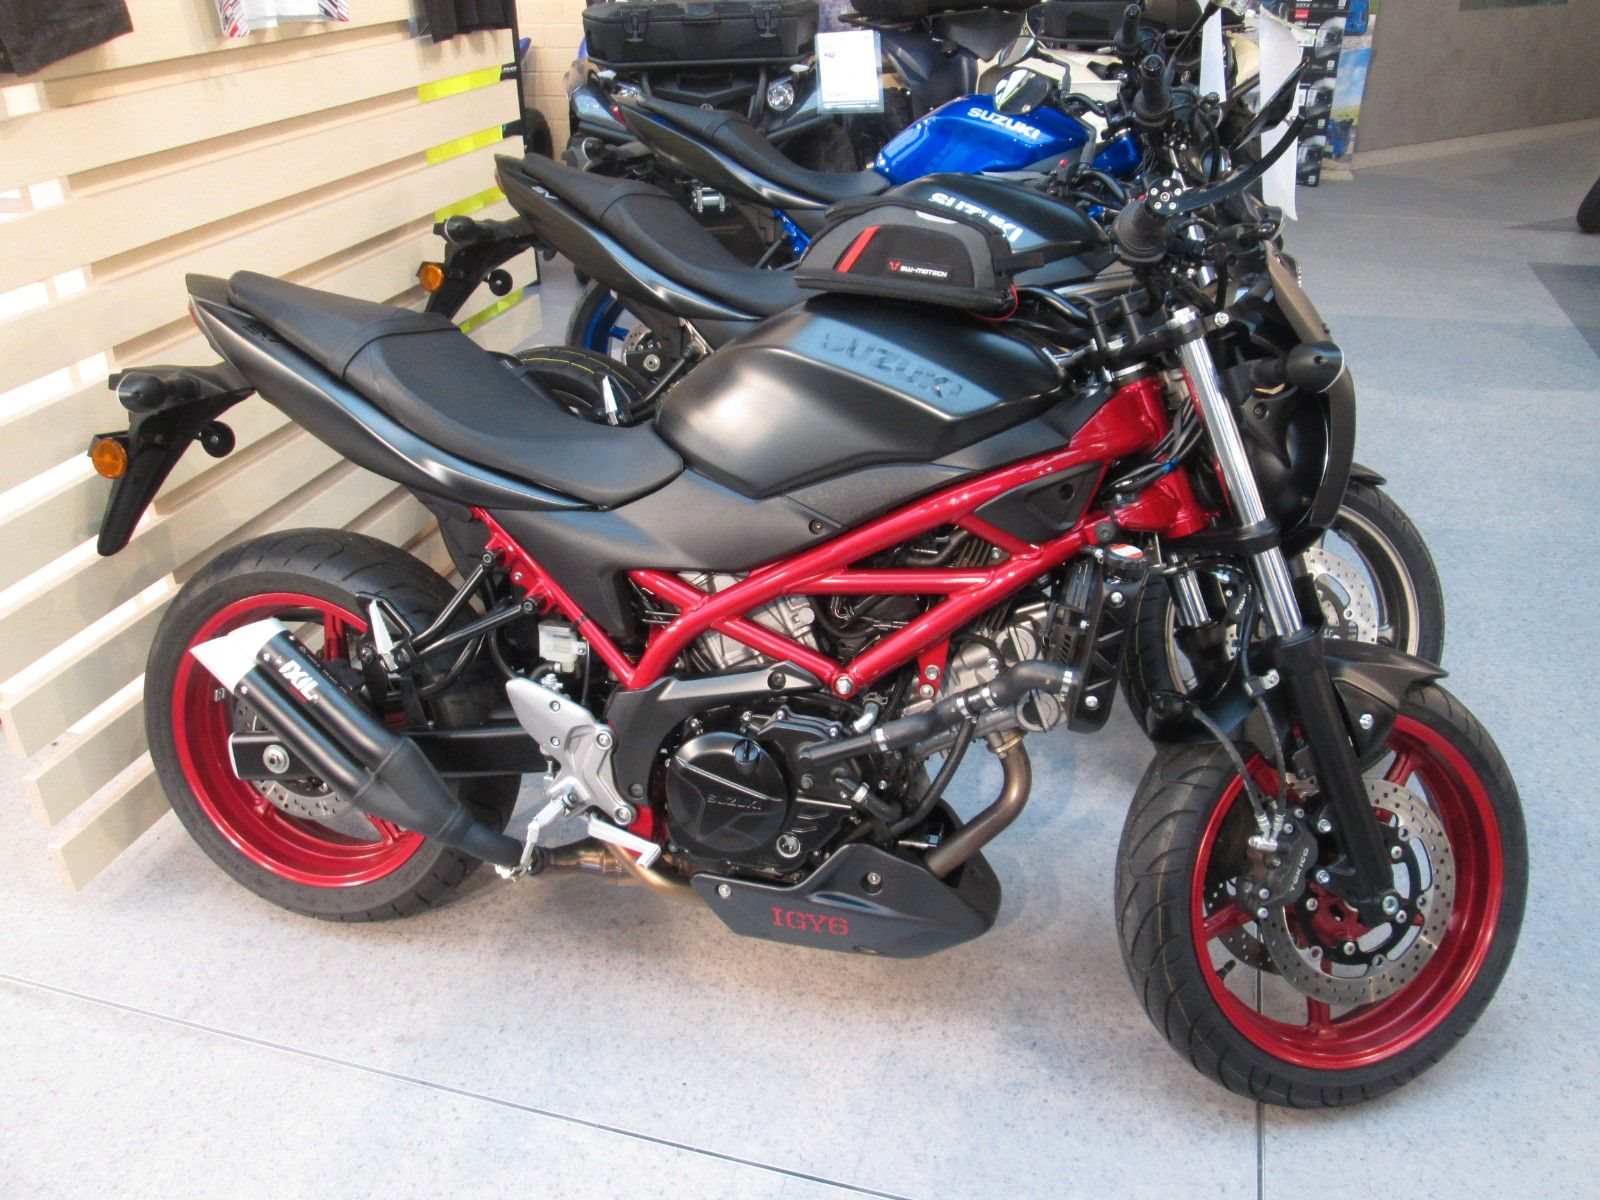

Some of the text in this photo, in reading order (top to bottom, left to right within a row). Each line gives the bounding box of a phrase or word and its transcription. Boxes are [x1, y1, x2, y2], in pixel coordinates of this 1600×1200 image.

[967, 107, 1041, 140] SUZUKI
[821, 331, 965, 398] SUZUKI
[278, 660, 318, 701] IXIL
[1289, 847, 1309, 892] TOKICO
[771, 905, 849, 936] IGY6
